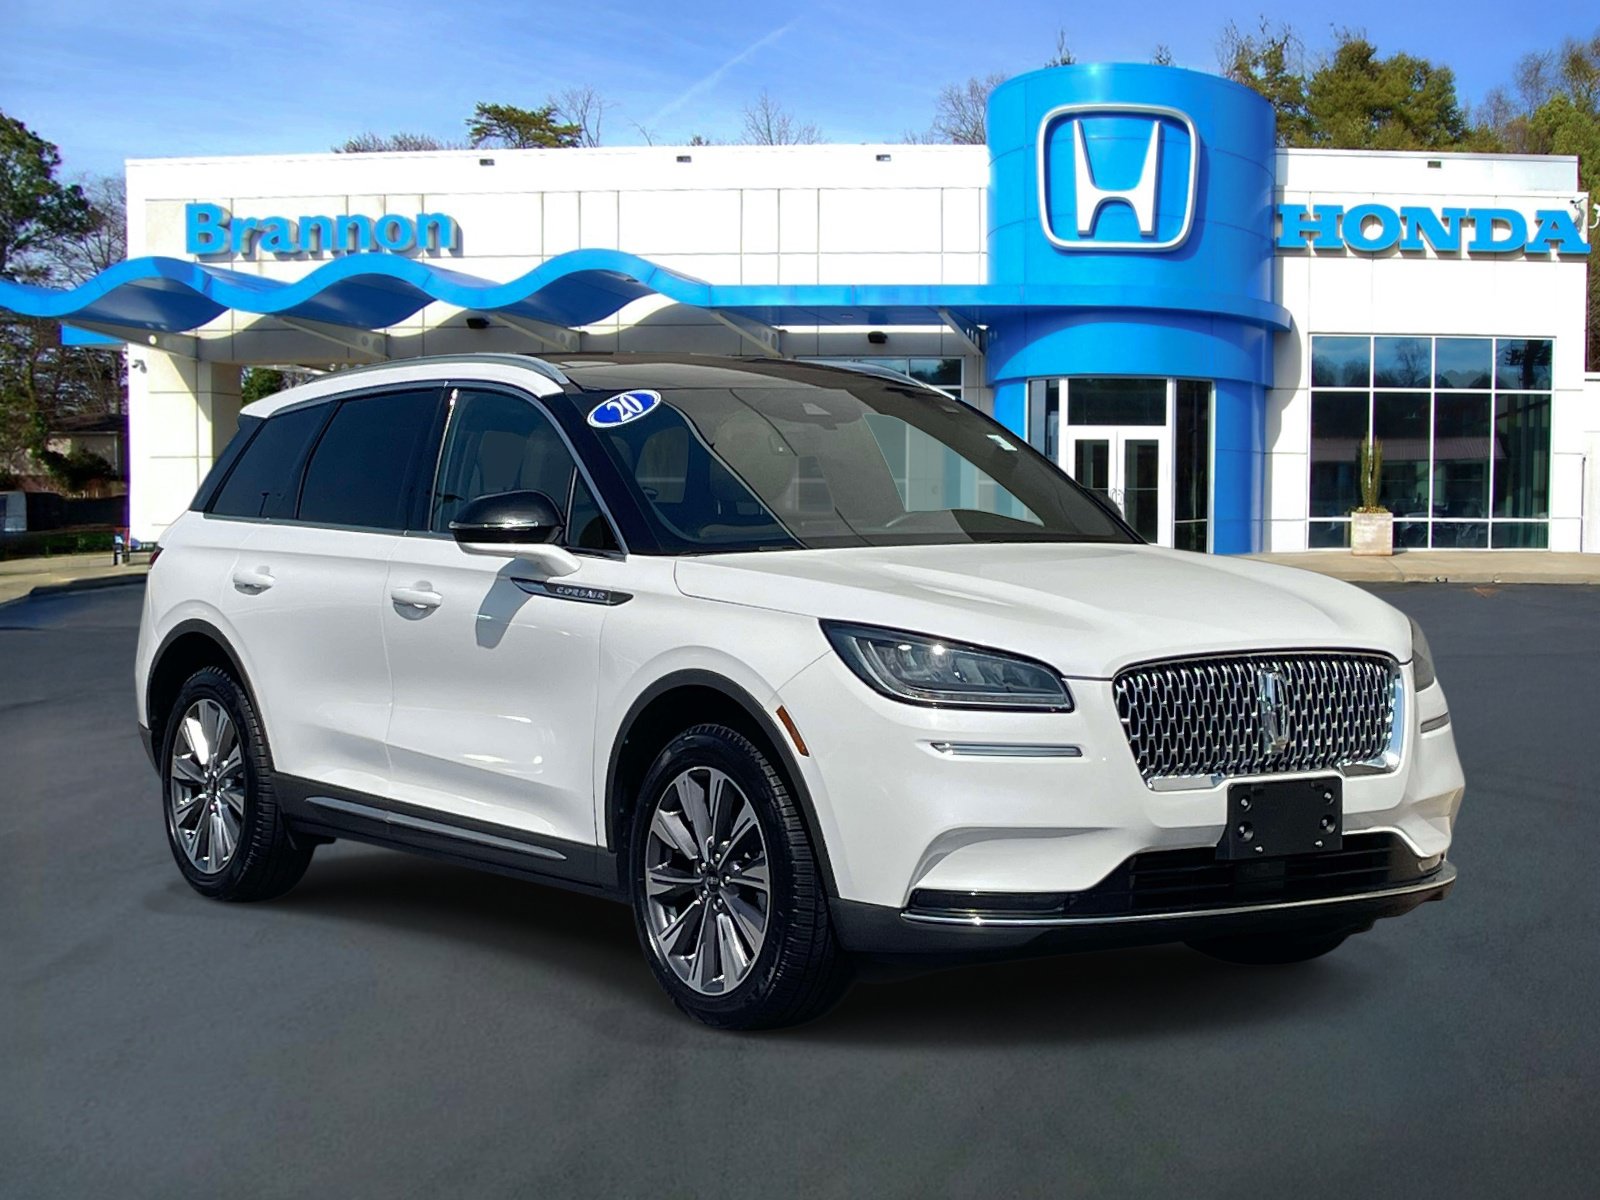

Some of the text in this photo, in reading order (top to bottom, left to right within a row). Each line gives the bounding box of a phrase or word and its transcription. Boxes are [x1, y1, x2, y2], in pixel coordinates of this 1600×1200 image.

[186, 202, 457, 256] Brannon
[1277, 203, 1591, 254] HONDA
[606, 394, 643, 422] 20
[556, 586, 605, 600] CORSAIR
